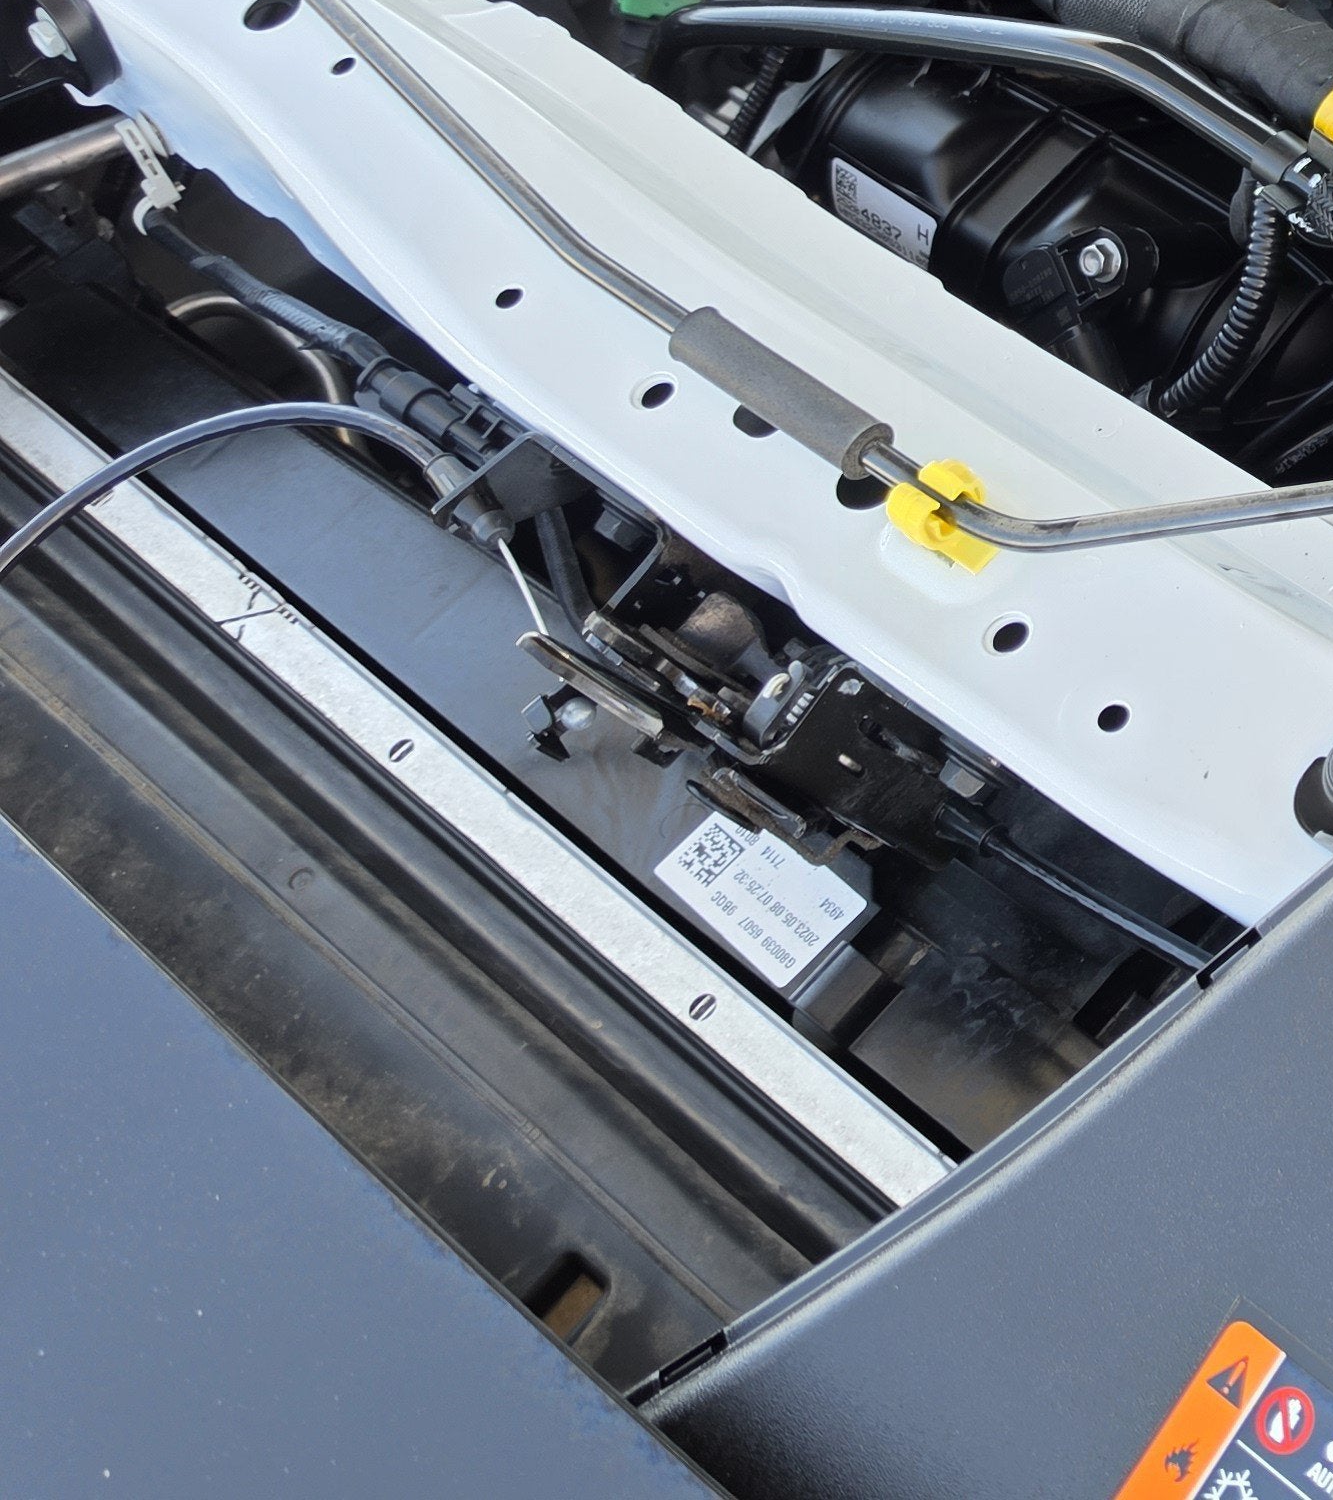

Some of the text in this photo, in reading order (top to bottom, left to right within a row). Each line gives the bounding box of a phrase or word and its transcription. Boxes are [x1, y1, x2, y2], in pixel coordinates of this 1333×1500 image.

[917, 223, 929, 246] H
[760, 845, 787, 870] 7114
[819, 898, 844, 921] 4934
[738, 916, 764, 940] 6507
[768, 900, 820, 948] 2023.05.08
